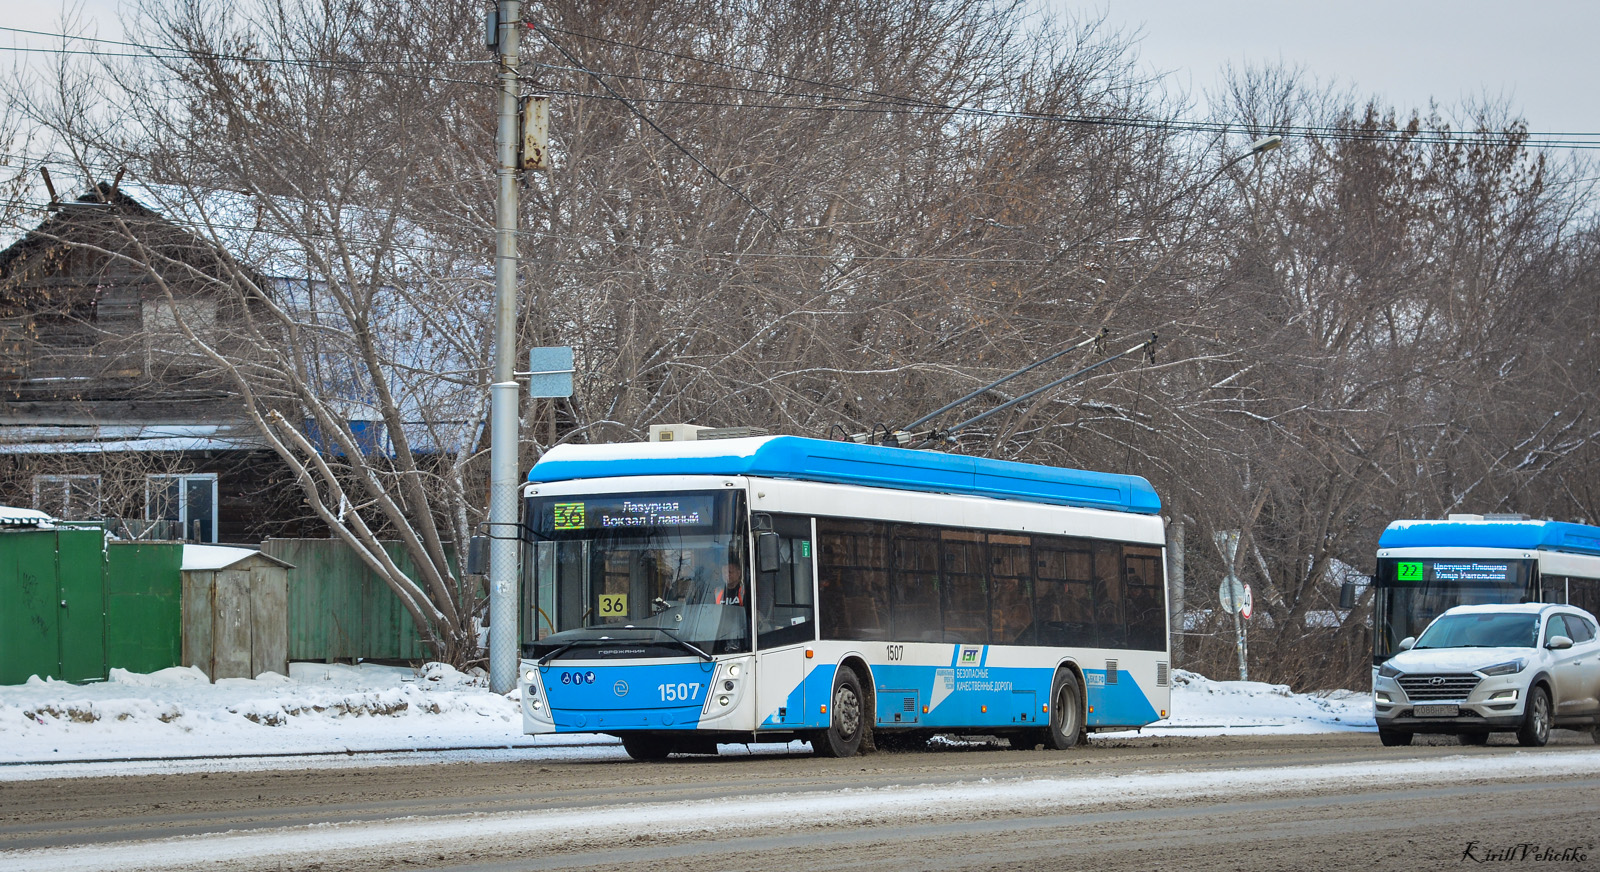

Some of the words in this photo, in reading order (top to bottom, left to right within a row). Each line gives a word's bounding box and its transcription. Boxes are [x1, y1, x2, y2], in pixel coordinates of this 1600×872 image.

[622, 501, 679, 513] Лазурная
[554, 505, 584, 527] 36
[602, 515, 646, 527] Вокзал
[650, 512, 700, 525] Главный
[1402, 564, 1418, 577] 22
[602, 597, 624, 613] 36
[886, 645, 904, 661] 1507
[956, 668, 989, 679] БЕЗОПАСНЫЕ
[657, 682, 700, 702] 1507
[956, 681, 994, 691] КАЧЕСТВЕННЫЕ
[994, 682, 1013, 692] ДОРОГИ
